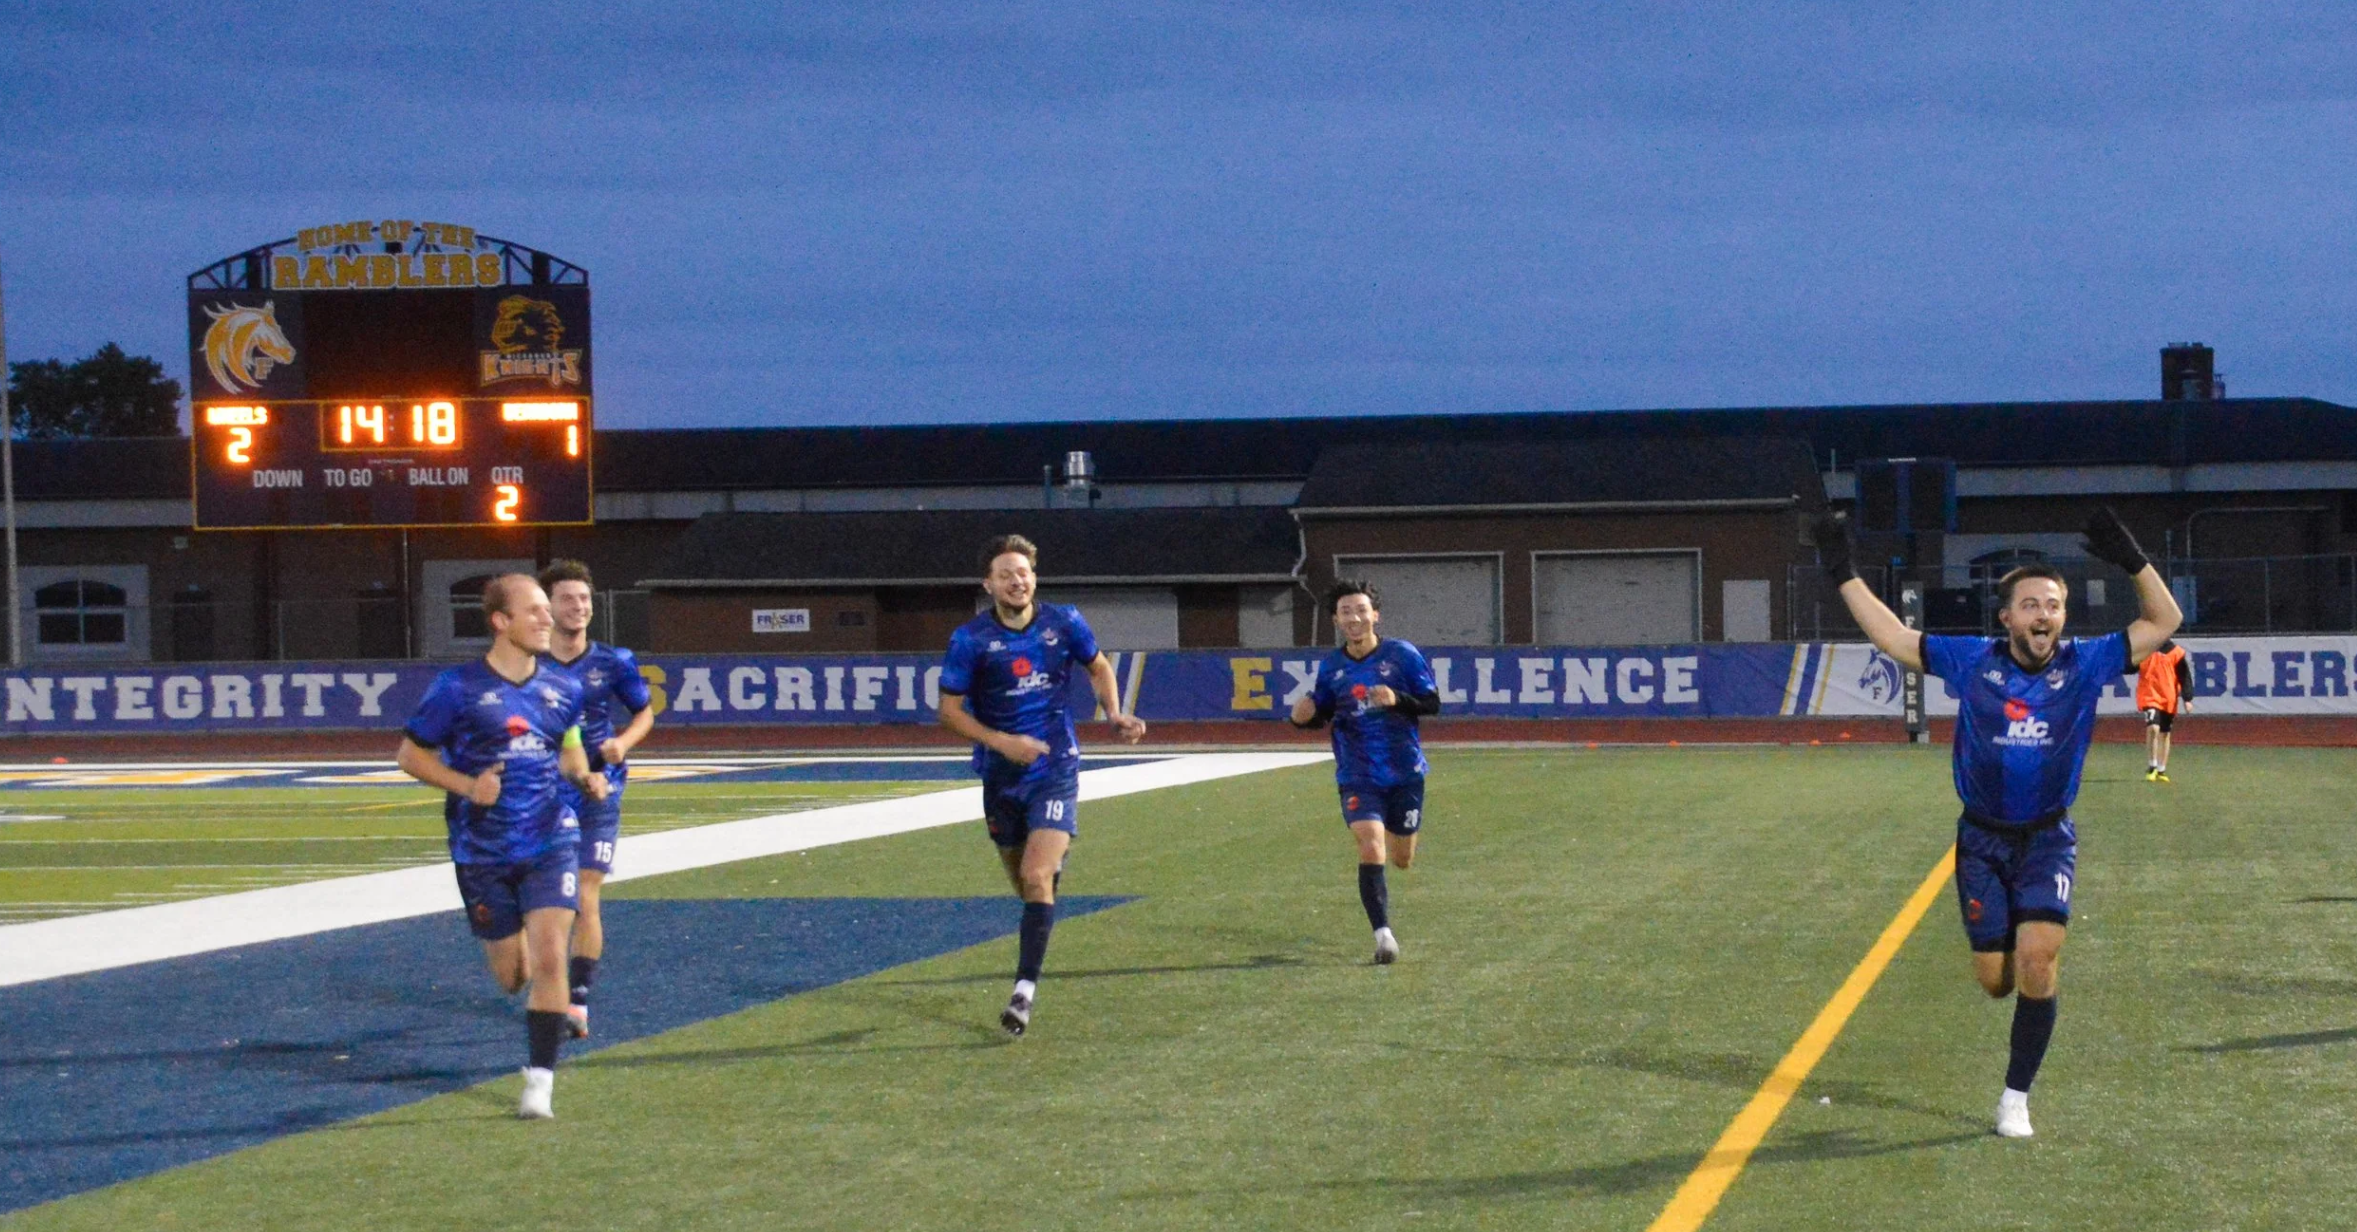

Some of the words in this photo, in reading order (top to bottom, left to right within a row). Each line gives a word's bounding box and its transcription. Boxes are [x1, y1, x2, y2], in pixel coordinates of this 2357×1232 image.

[298, 220, 373, 250] HOME
[380, 219, 414, 242] OF
[421, 221, 475, 249] THE
[272, 252, 502, 290] RAMBLERS
[227, 427, 252, 464] 2
[567, 424, 577, 456] 1
[253, 469, 303, 488] DOWN
[324, 468, 346, 487] TO
[350, 468, 372, 487] GO
[409, 468, 446, 486] BALL
[447, 467, 469, 485] ON
[491, 466, 524, 485] QTR
[495, 485, 519, 521] 2
[1231, 656, 1700, 711] EXLLENCE
[2007, 716, 2049, 739] idc
[1045, 799, 1064, 822] 19
[594, 841, 612, 864] 15
[561, 872, 577, 897] 8
